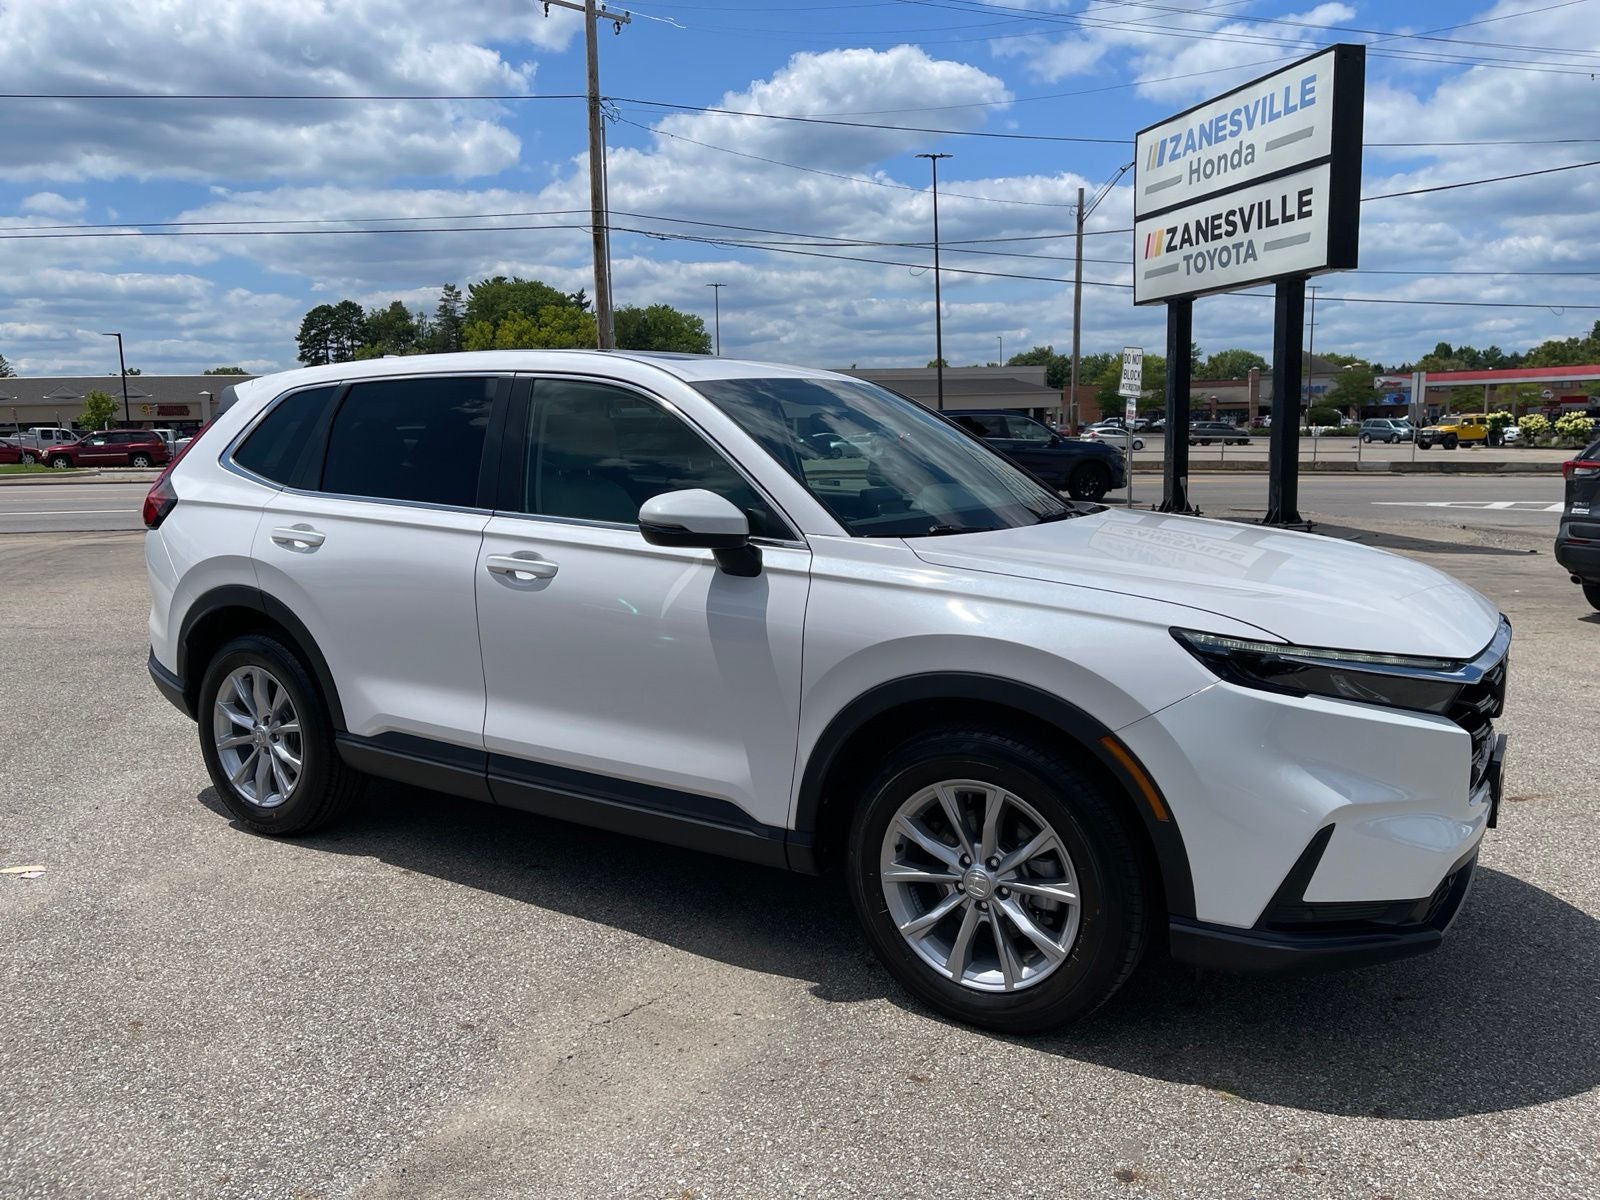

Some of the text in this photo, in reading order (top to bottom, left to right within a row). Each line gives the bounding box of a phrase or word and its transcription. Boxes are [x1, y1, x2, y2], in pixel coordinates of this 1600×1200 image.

[1168, 74, 1318, 163] ZANESVILLE
[1188, 140, 1256, 185] Honda
[1165, 187, 1314, 253] ZANESVILLE
[1182, 239, 1258, 276] TOYOTA
[1123, 369, 1141, 380] BLOCK
